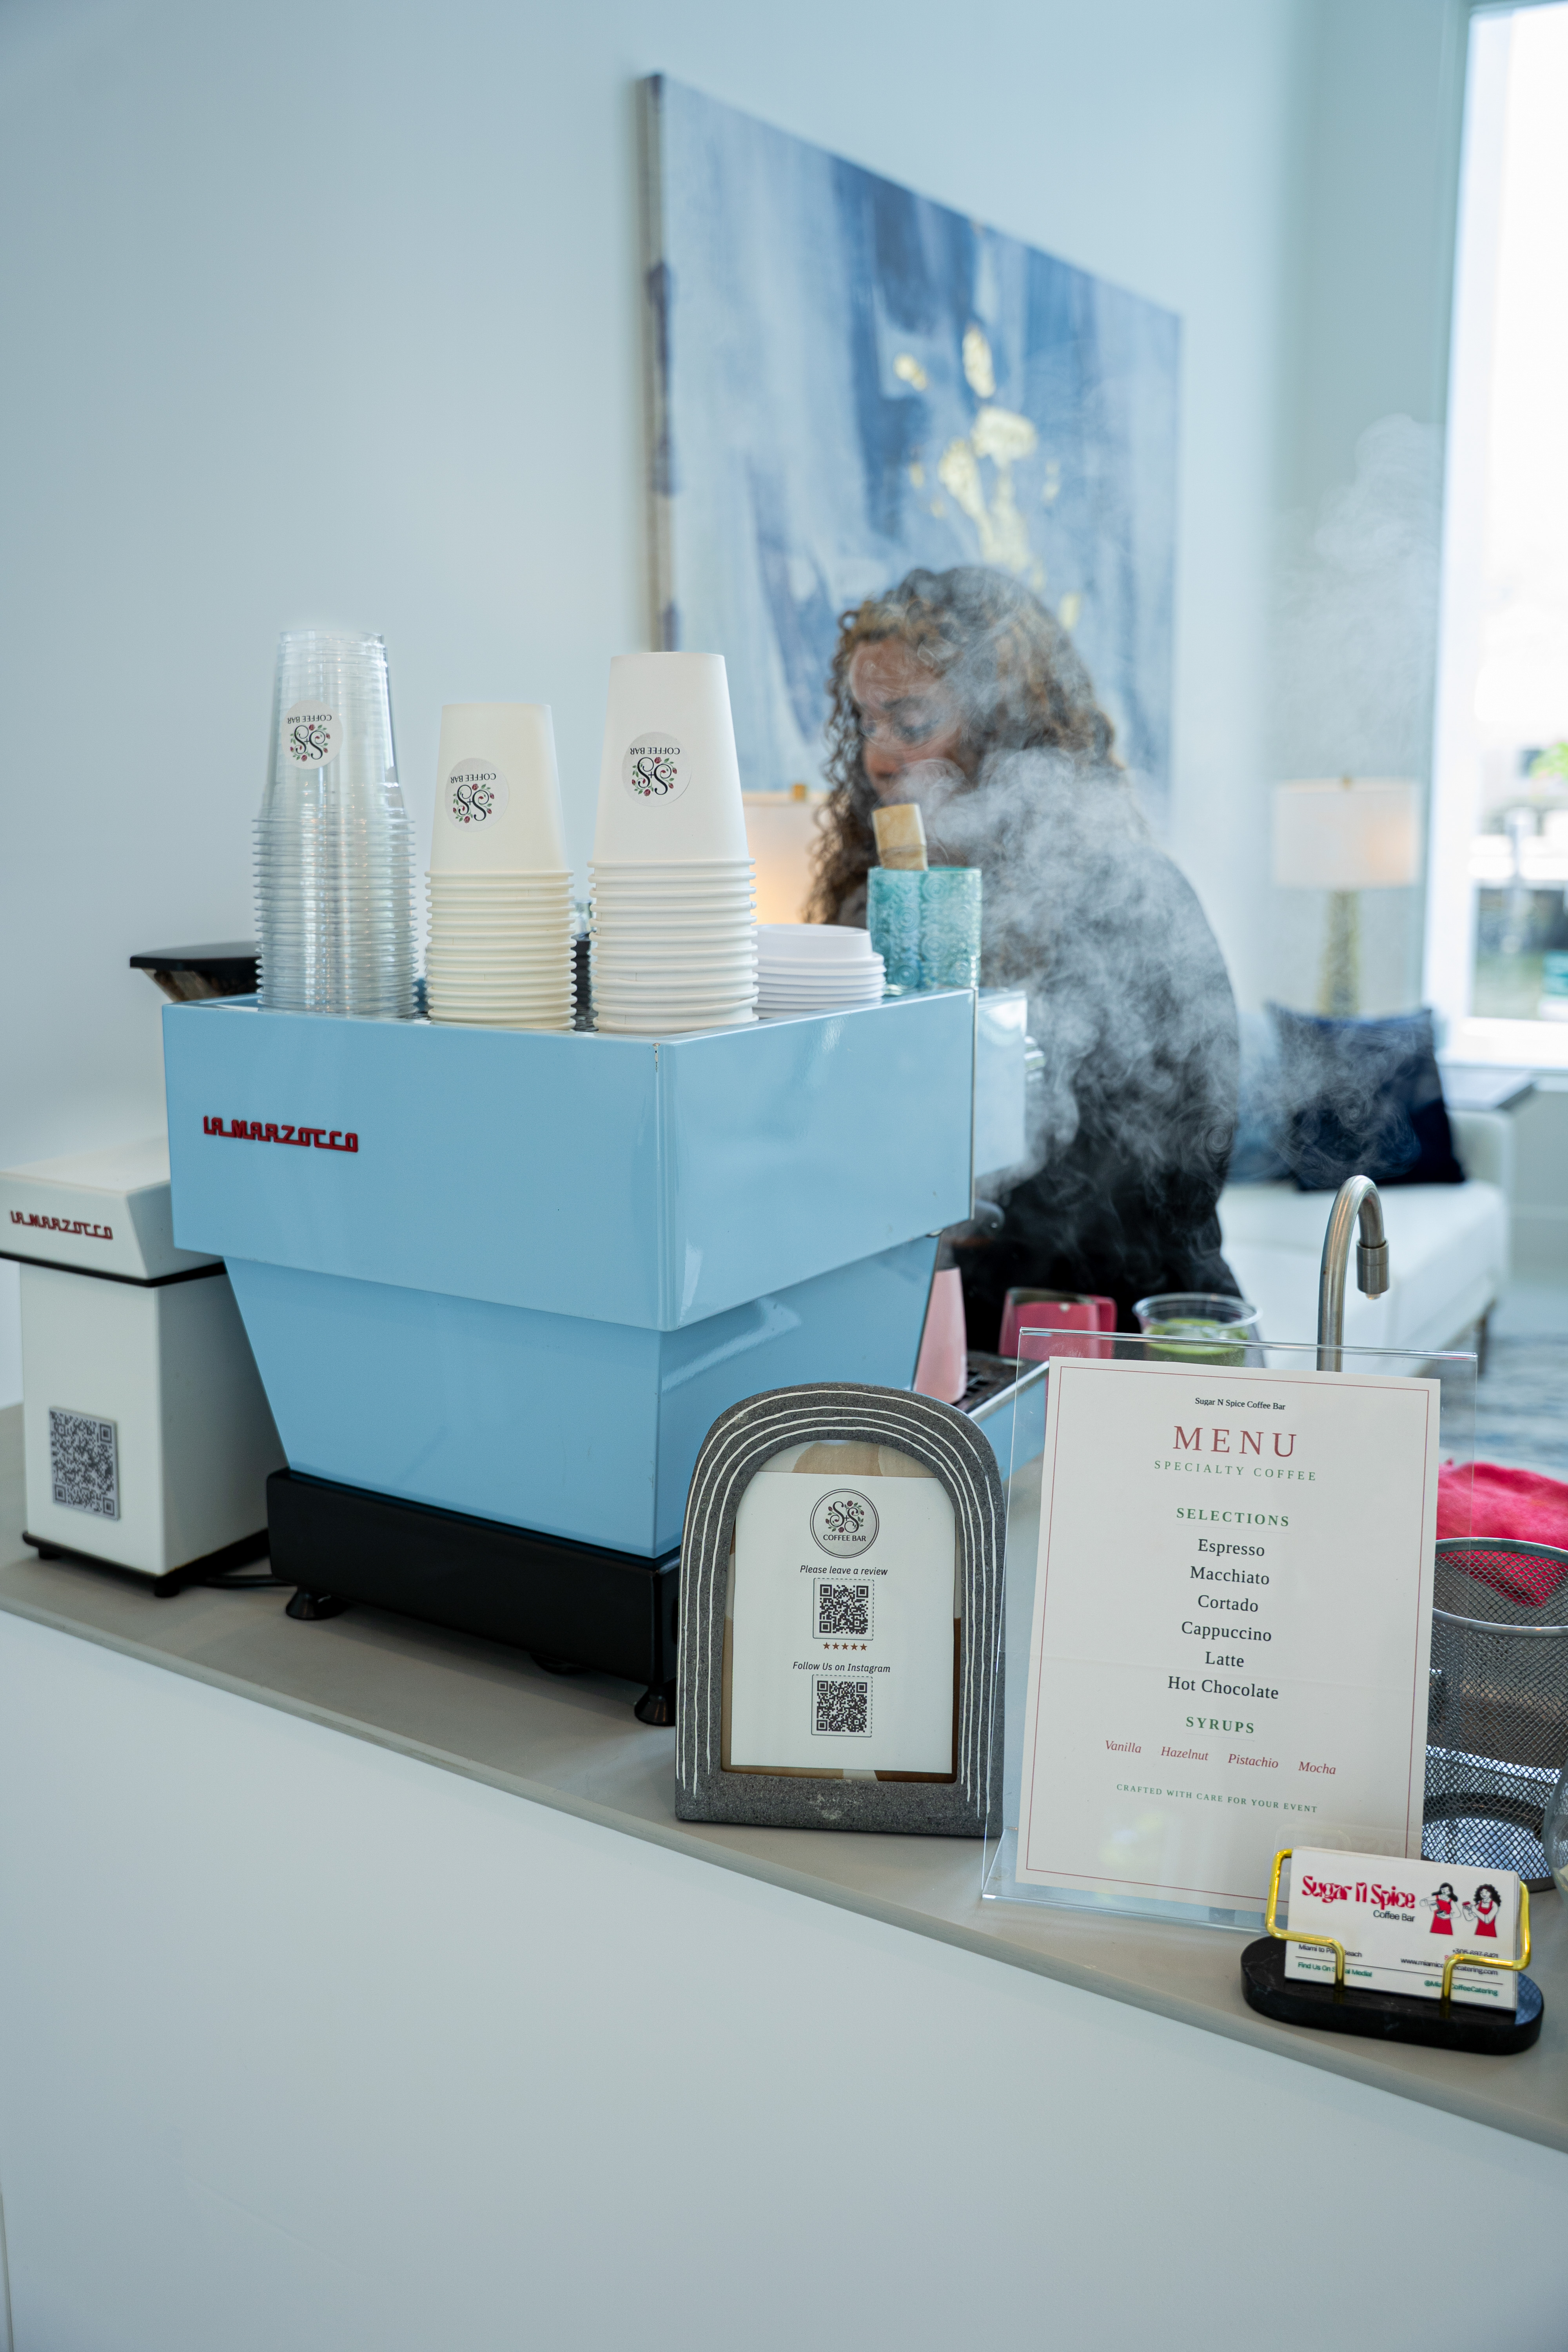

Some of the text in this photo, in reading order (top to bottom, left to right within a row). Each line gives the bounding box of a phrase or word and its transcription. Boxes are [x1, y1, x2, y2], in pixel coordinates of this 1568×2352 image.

[287, 716, 300, 724] BAR
[630, 747, 645, 755] BAR
[450, 773, 497, 784] COFFEE BAR
[203, 1116, 359, 1153] LA MARZOCCO
[10, 1211, 113, 1240] LA MARZOCCO
[1195, 1397, 1216, 1406] Sugar
[1225, 1399, 1245, 1408] Spice
[1246, 1401, 1271, 1409] Coffee
[1173, 1426, 1297, 1457] MENU
[1154, 1460, 1316, 1481] SPECIALTY COFFEE
[1176, 1508, 1289, 1526] SELECTIONS
[1198, 1539, 1265, 1557] Espresso
[800, 1565, 827, 1574] Please
[829, 1566, 851, 1575] leave
[860, 1567, 889, 1576] review
[1190, 1566, 1270, 1585] Macchiato
[1198, 1595, 1258, 1612] Cortado
[1181, 1621, 1272, 1642] Cappuccino
[793, 1661, 820, 1670] Follow
[822, 1662, 832, 1671] Us
[847, 1663, 891, 1674] Instagram
[1205, 1651, 1244, 1668] Latte
[1168, 1676, 1279, 1699] Hot Chocolate
[1186, 1717, 1254, 1733] SYRUPS
[1105, 1740, 1336, 1775] Vanilla Hazelnut Pistachio Mocha
[1116, 1784, 1317, 1813] CRAFTED WITH CARE FOR YOUR EVENT
[1302, 1876, 1352, 1904] Sugar
[1370, 1884, 1416, 1910] Spice
[1373, 1909, 1415, 1922] Coffee Bar
